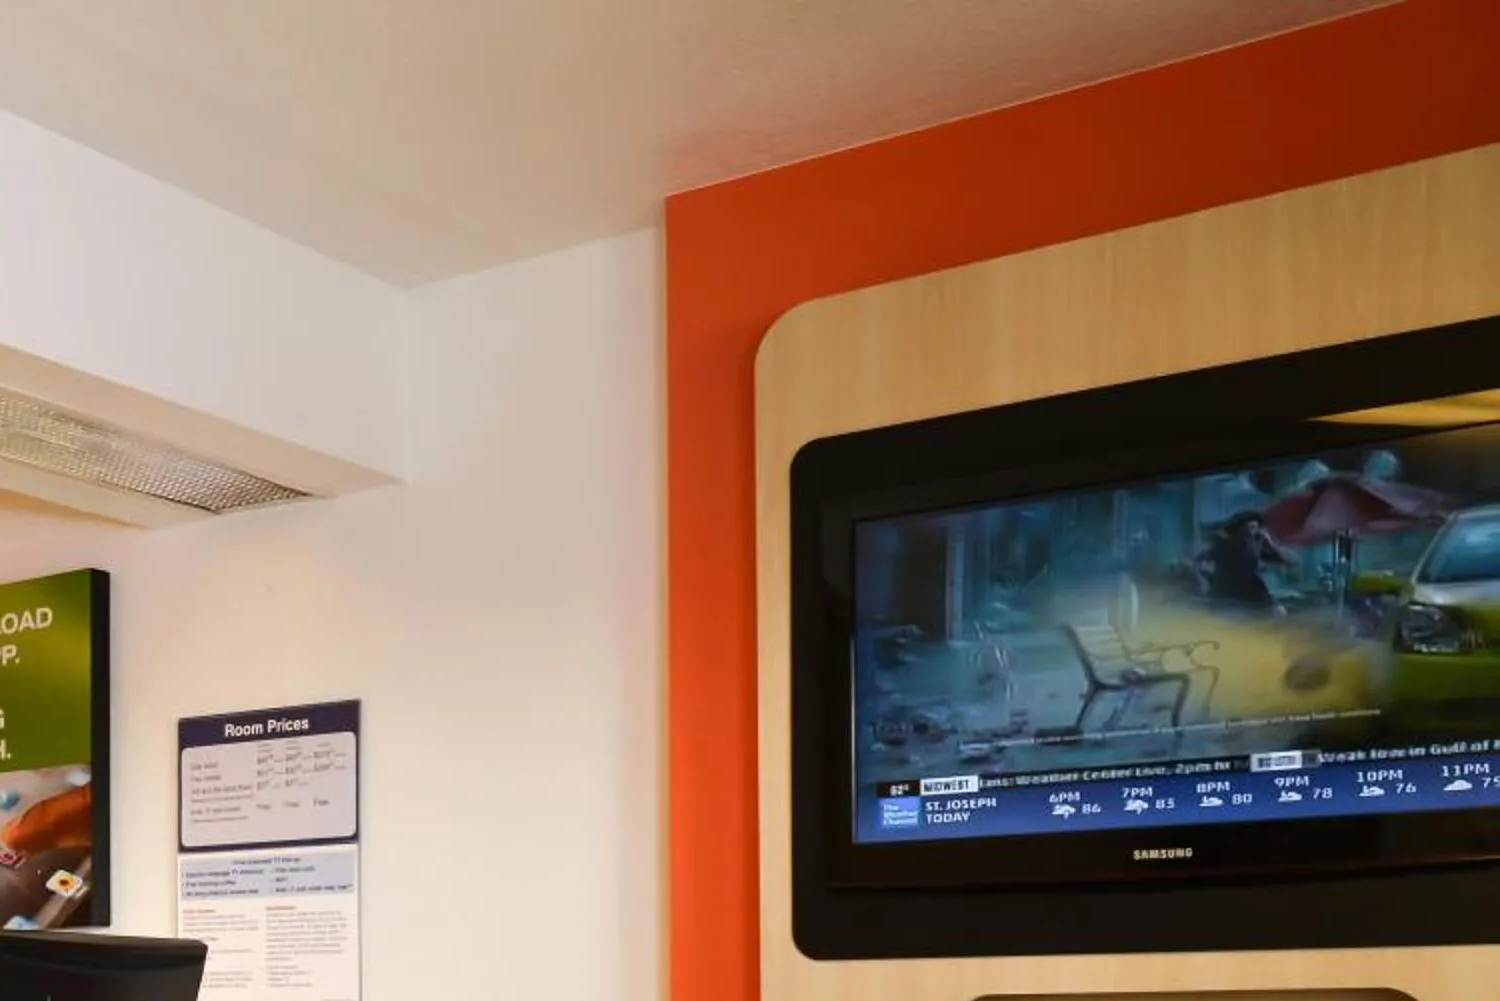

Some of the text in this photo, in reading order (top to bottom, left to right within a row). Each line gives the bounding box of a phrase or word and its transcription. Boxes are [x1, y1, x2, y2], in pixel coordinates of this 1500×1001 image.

[224, 718, 309, 738] Room Prices
[1356, 769, 1404, 783] 10PM
[1441, 763, 1490, 777] 11PM
[1197, 781, 1230, 793] 8PM
[1275, 775, 1309, 788] 9PM
[1121, 787, 1153, 798] 7PM
[1312, 787, 1333, 799] 78
[1396, 782, 1417, 794] 76
[946, 797, 997, 811] JOSEPH
[1049, 792, 1080, 804] 6PM
[1081, 803, 1101, 814] 86
[926, 812, 970, 824] TODAY
[1133, 848, 1193, 860] SAMSUNG
